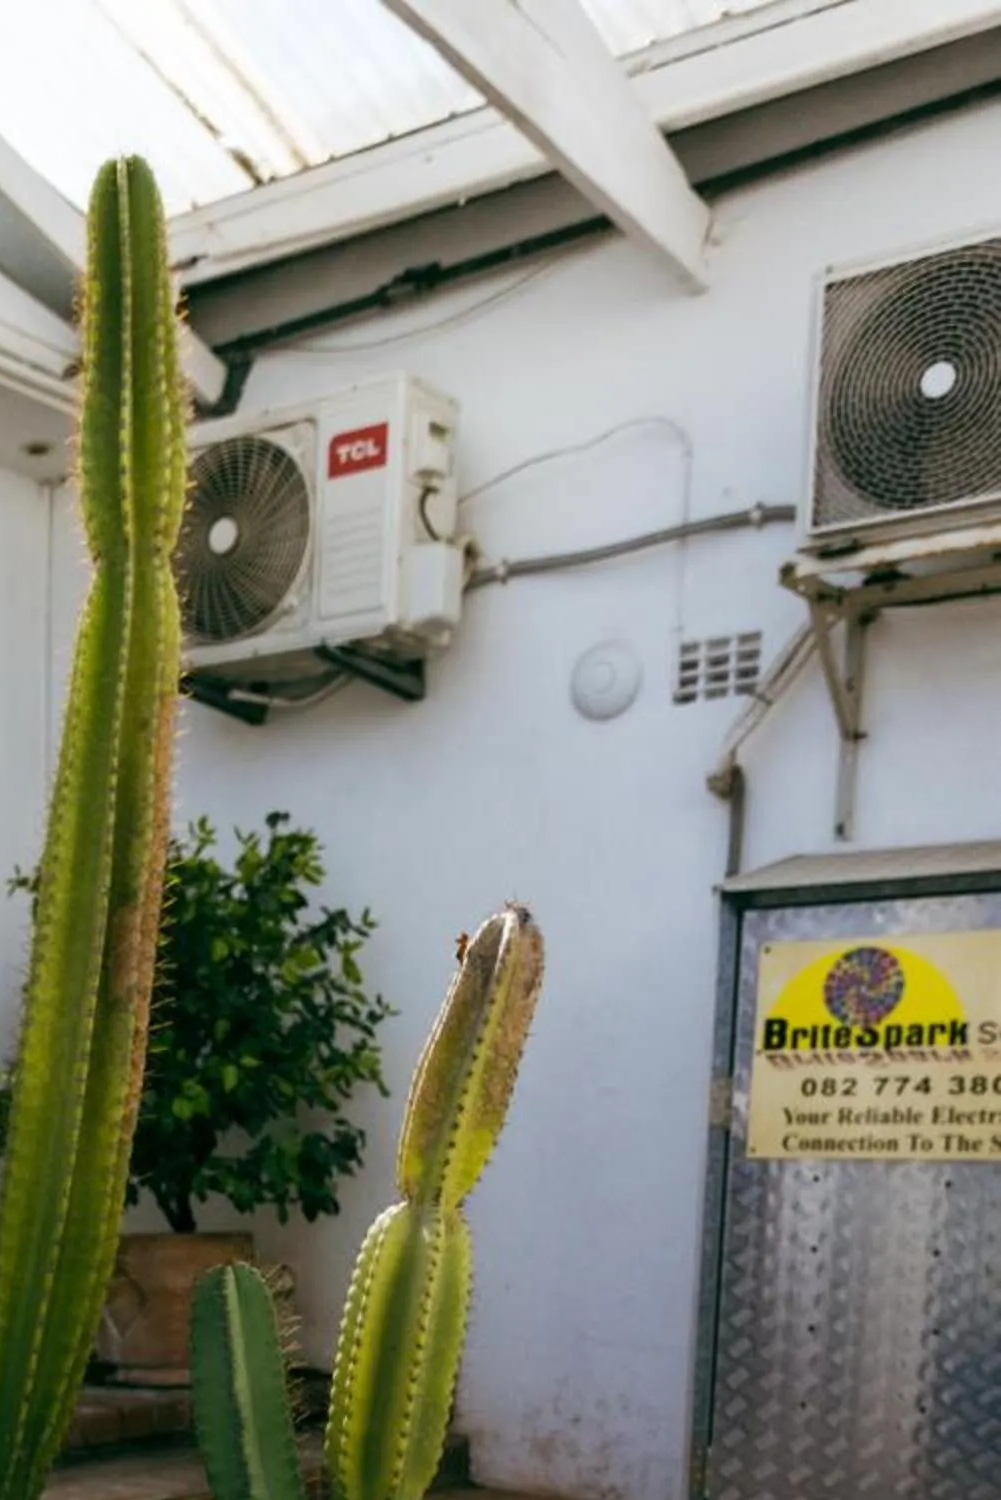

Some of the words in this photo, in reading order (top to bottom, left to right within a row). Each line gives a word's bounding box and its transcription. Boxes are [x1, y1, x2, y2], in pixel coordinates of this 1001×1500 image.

[335, 438, 380, 465] TCL
[762, 1018, 968, 1051] BriteSpark
[977, 1020, 1001, 1045] S
[801, 1077, 858, 1097] 082
[874, 1076, 931, 1096] 774
[783, 1106, 830, 1126] Your
[838, 1106, 923, 1126] Reliable
[931, 1105, 1001, 1126] Electr
[782, 1134, 898, 1152] Connection
[907, 1133, 934, 1152] To
[940, 1133, 983, 1152] The
